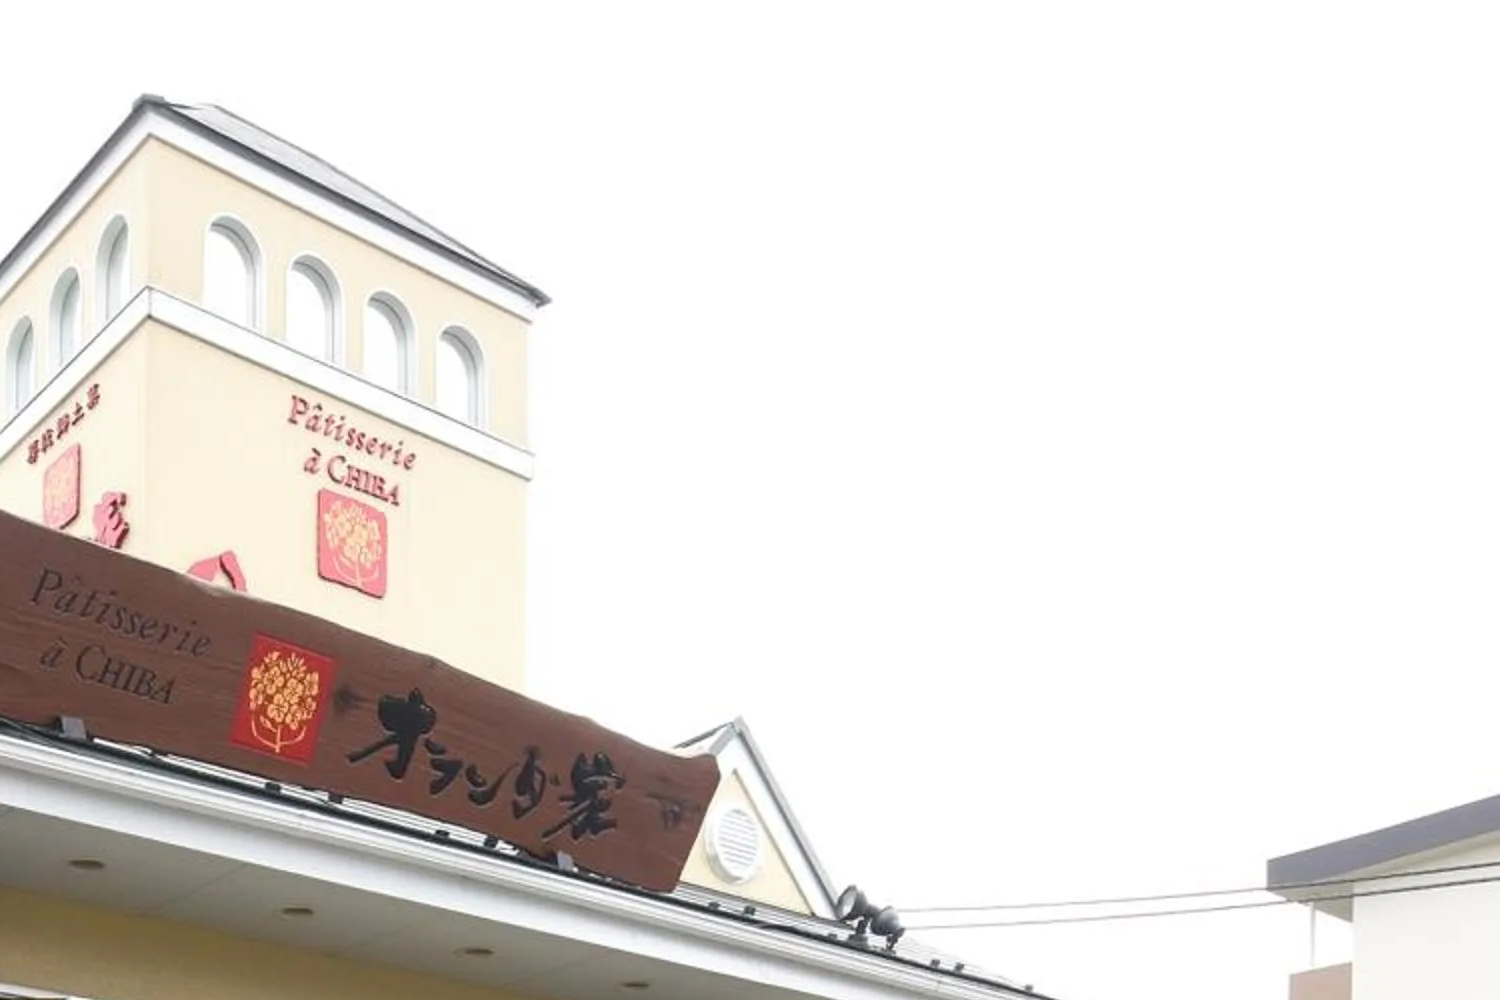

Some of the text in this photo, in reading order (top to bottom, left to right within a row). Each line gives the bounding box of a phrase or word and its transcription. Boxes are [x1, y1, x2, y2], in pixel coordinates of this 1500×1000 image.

[287, 394, 417, 471] Pâtisserie
[303, 447, 400, 507] à CHIBA
[30, 568, 211, 657] Pâtisserie
[38, 636, 176, 705] à CHIBA
